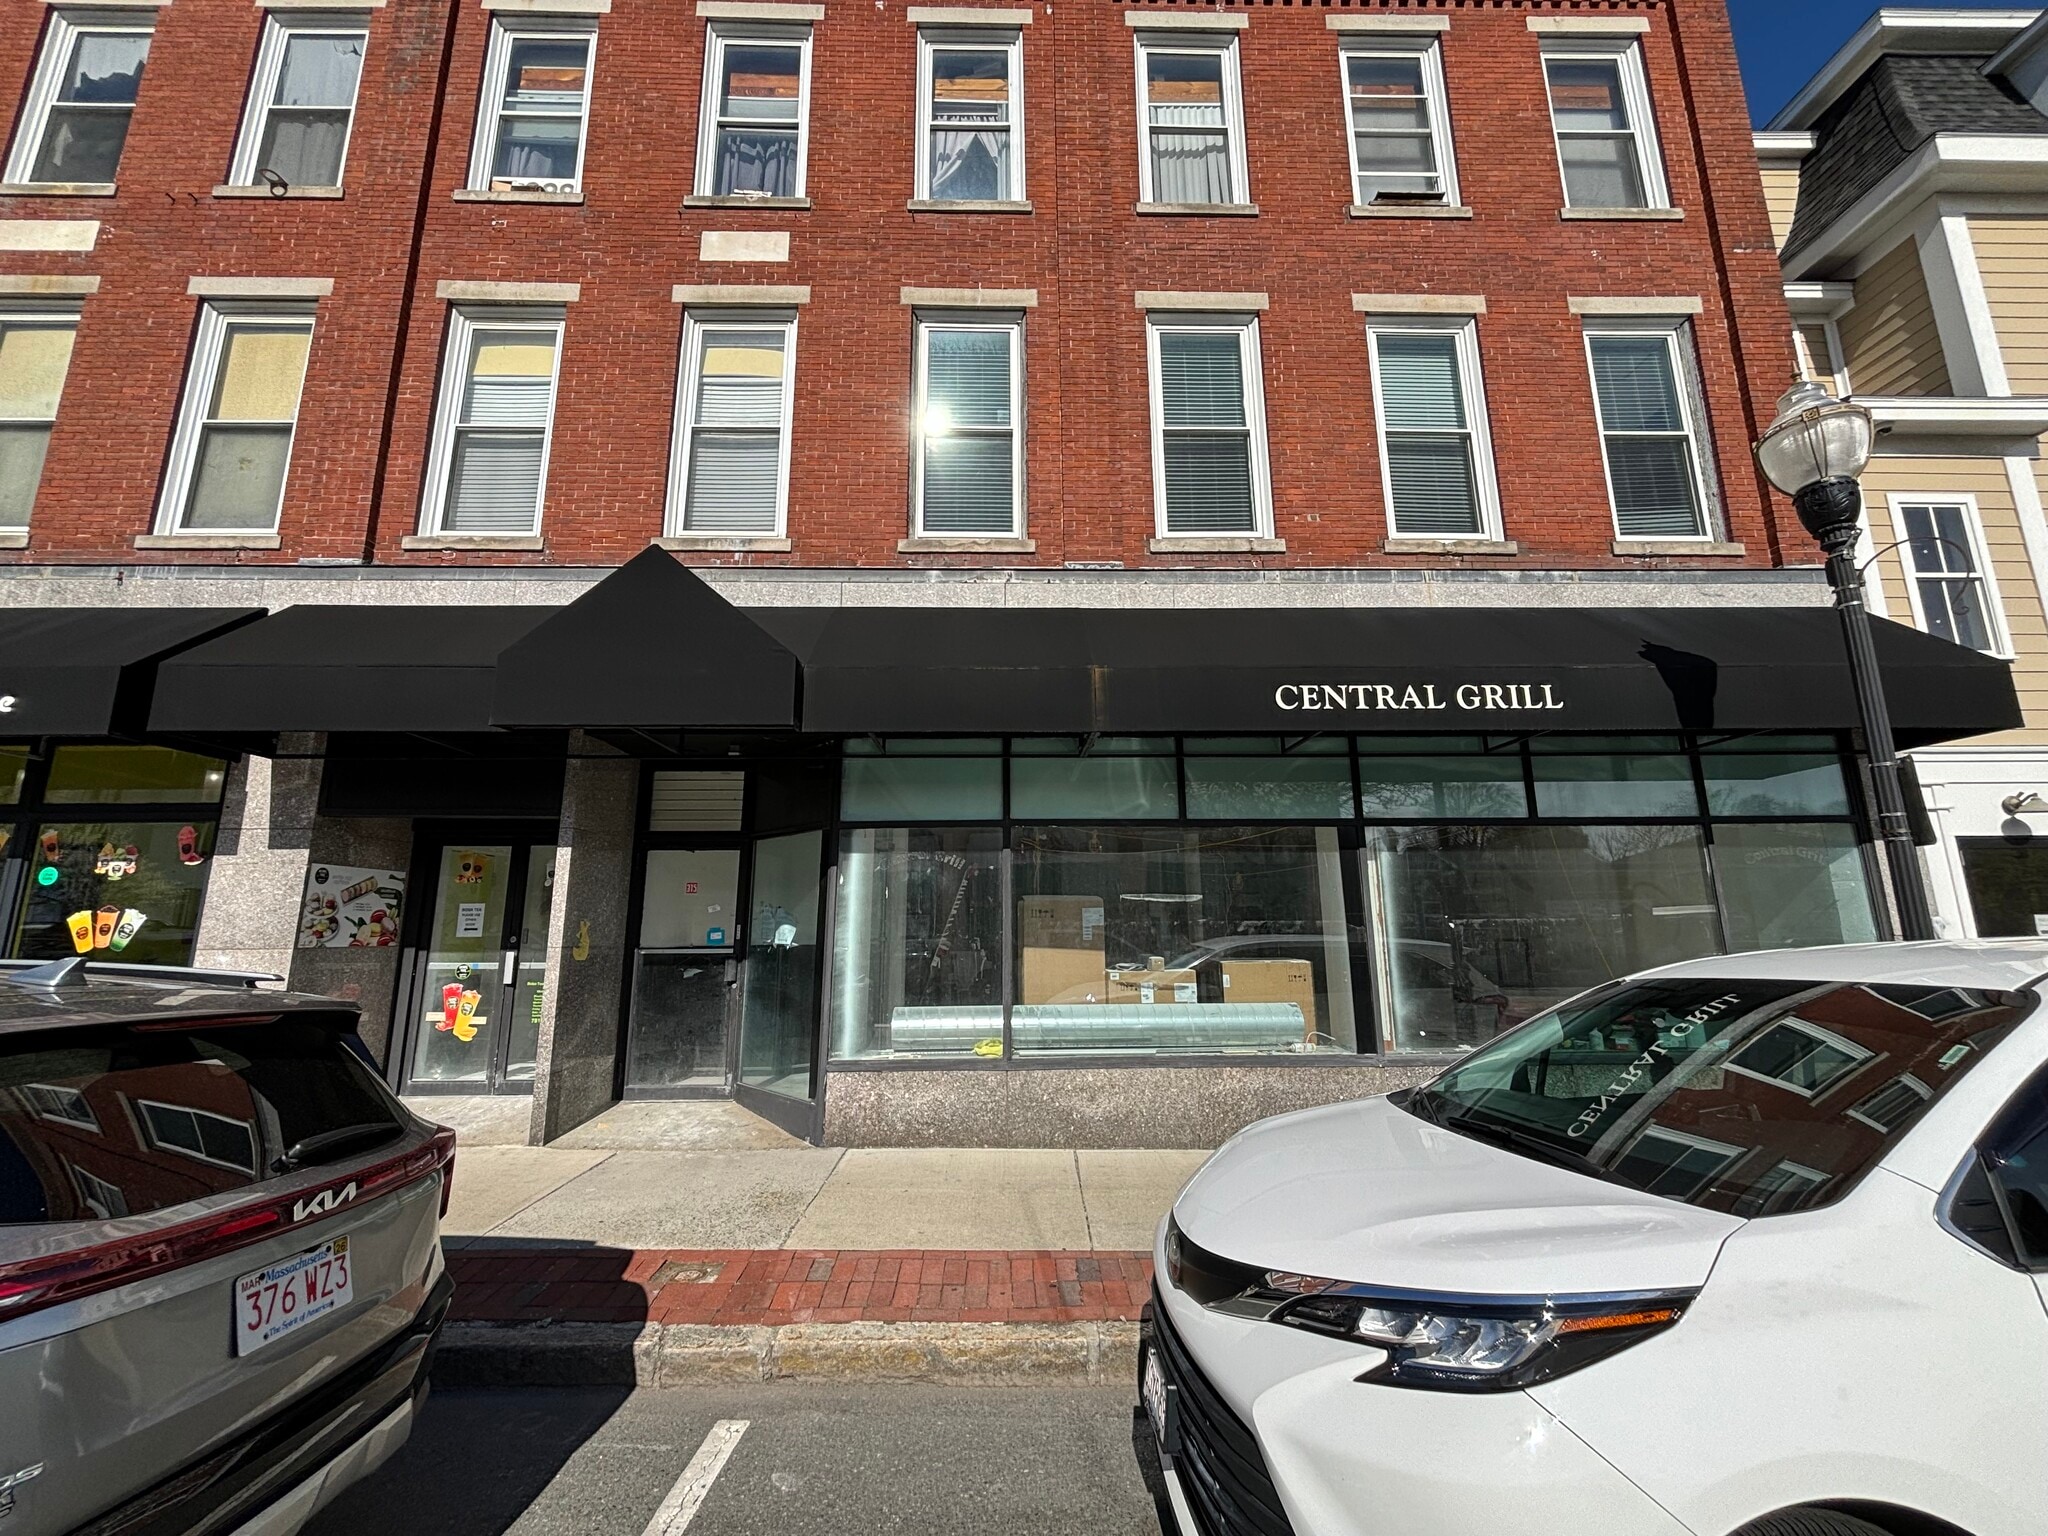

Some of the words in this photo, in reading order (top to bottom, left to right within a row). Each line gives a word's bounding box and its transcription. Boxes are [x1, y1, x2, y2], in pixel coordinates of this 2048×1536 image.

[1275, 684, 1446, 710] CENTRAL
[1456, 684, 1564, 710] GRILL
[241, 1276, 261, 1294] MAR
[264, 1249, 329, 1284] Massachusetts
[246, 1275, 296, 1331] 376
[305, 1254, 348, 1305] WZ3
